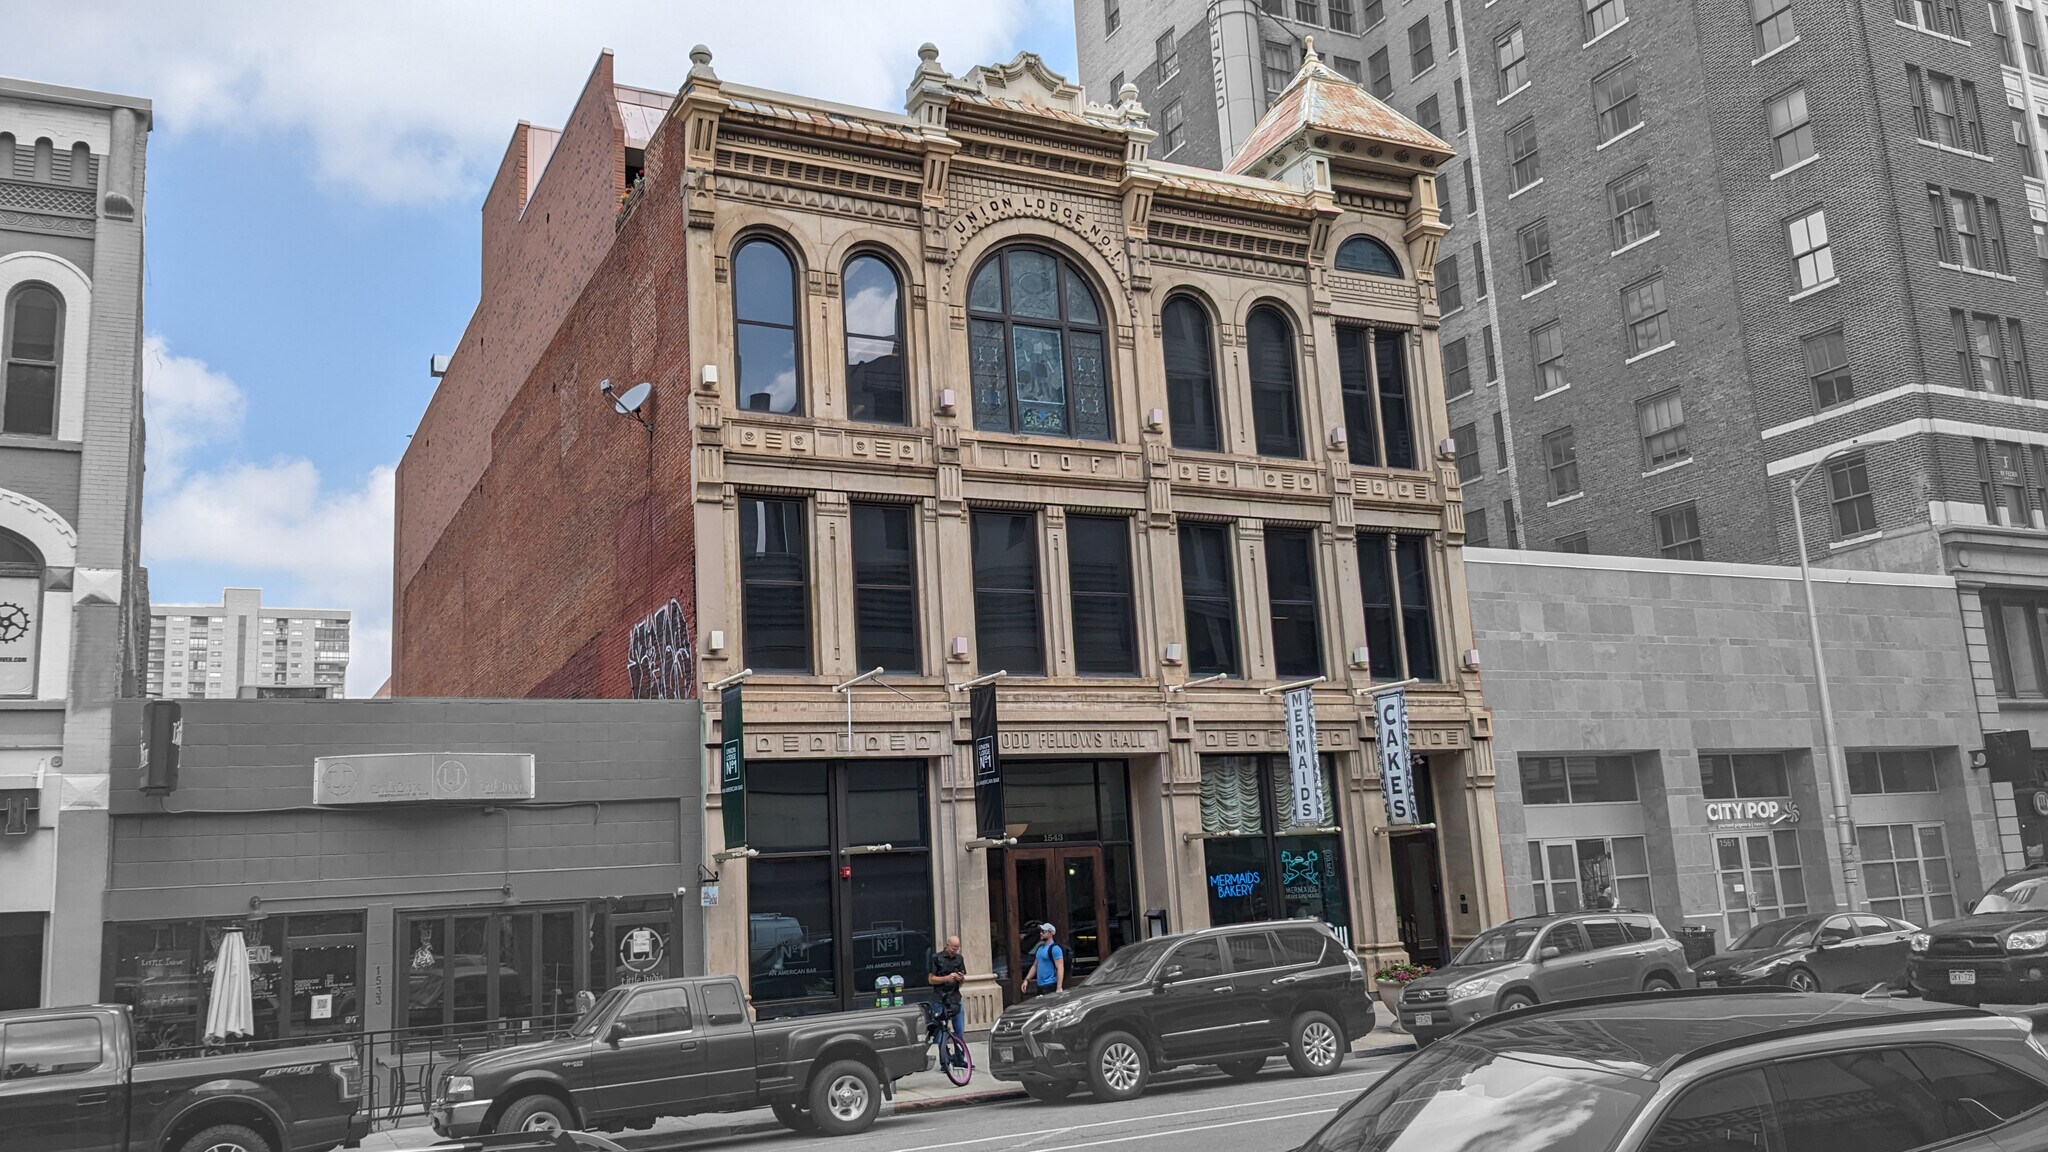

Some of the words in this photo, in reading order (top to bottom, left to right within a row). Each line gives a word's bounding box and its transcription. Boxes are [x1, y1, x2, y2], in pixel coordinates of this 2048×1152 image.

[953, 197, 1013, 234] UNION
[1023, 196, 1085, 226] LODGE
[1002, 732, 1031, 749] ODD
[1039, 731, 1103, 748] FELLOWS
[1110, 731, 1146, 748] HALL
[1291, 692, 1313, 818] MERMAIDS
[1383, 703, 1406, 819] CAKES
[1706, 803, 1743, 821] CITY
[1745, 801, 1779, 819] POP
[1043, 833, 1064, 842] 1543
[1719, 839, 1735, 848] 1561
[1209, 870, 1261, 887] MERMAIDS
[1217, 883, 1254, 899] BAKERY
[777, 968, 806, 977] AMERICAN
[874, 961, 901, 969] AMERICAN
[375, 966, 383, 1006] 1533
